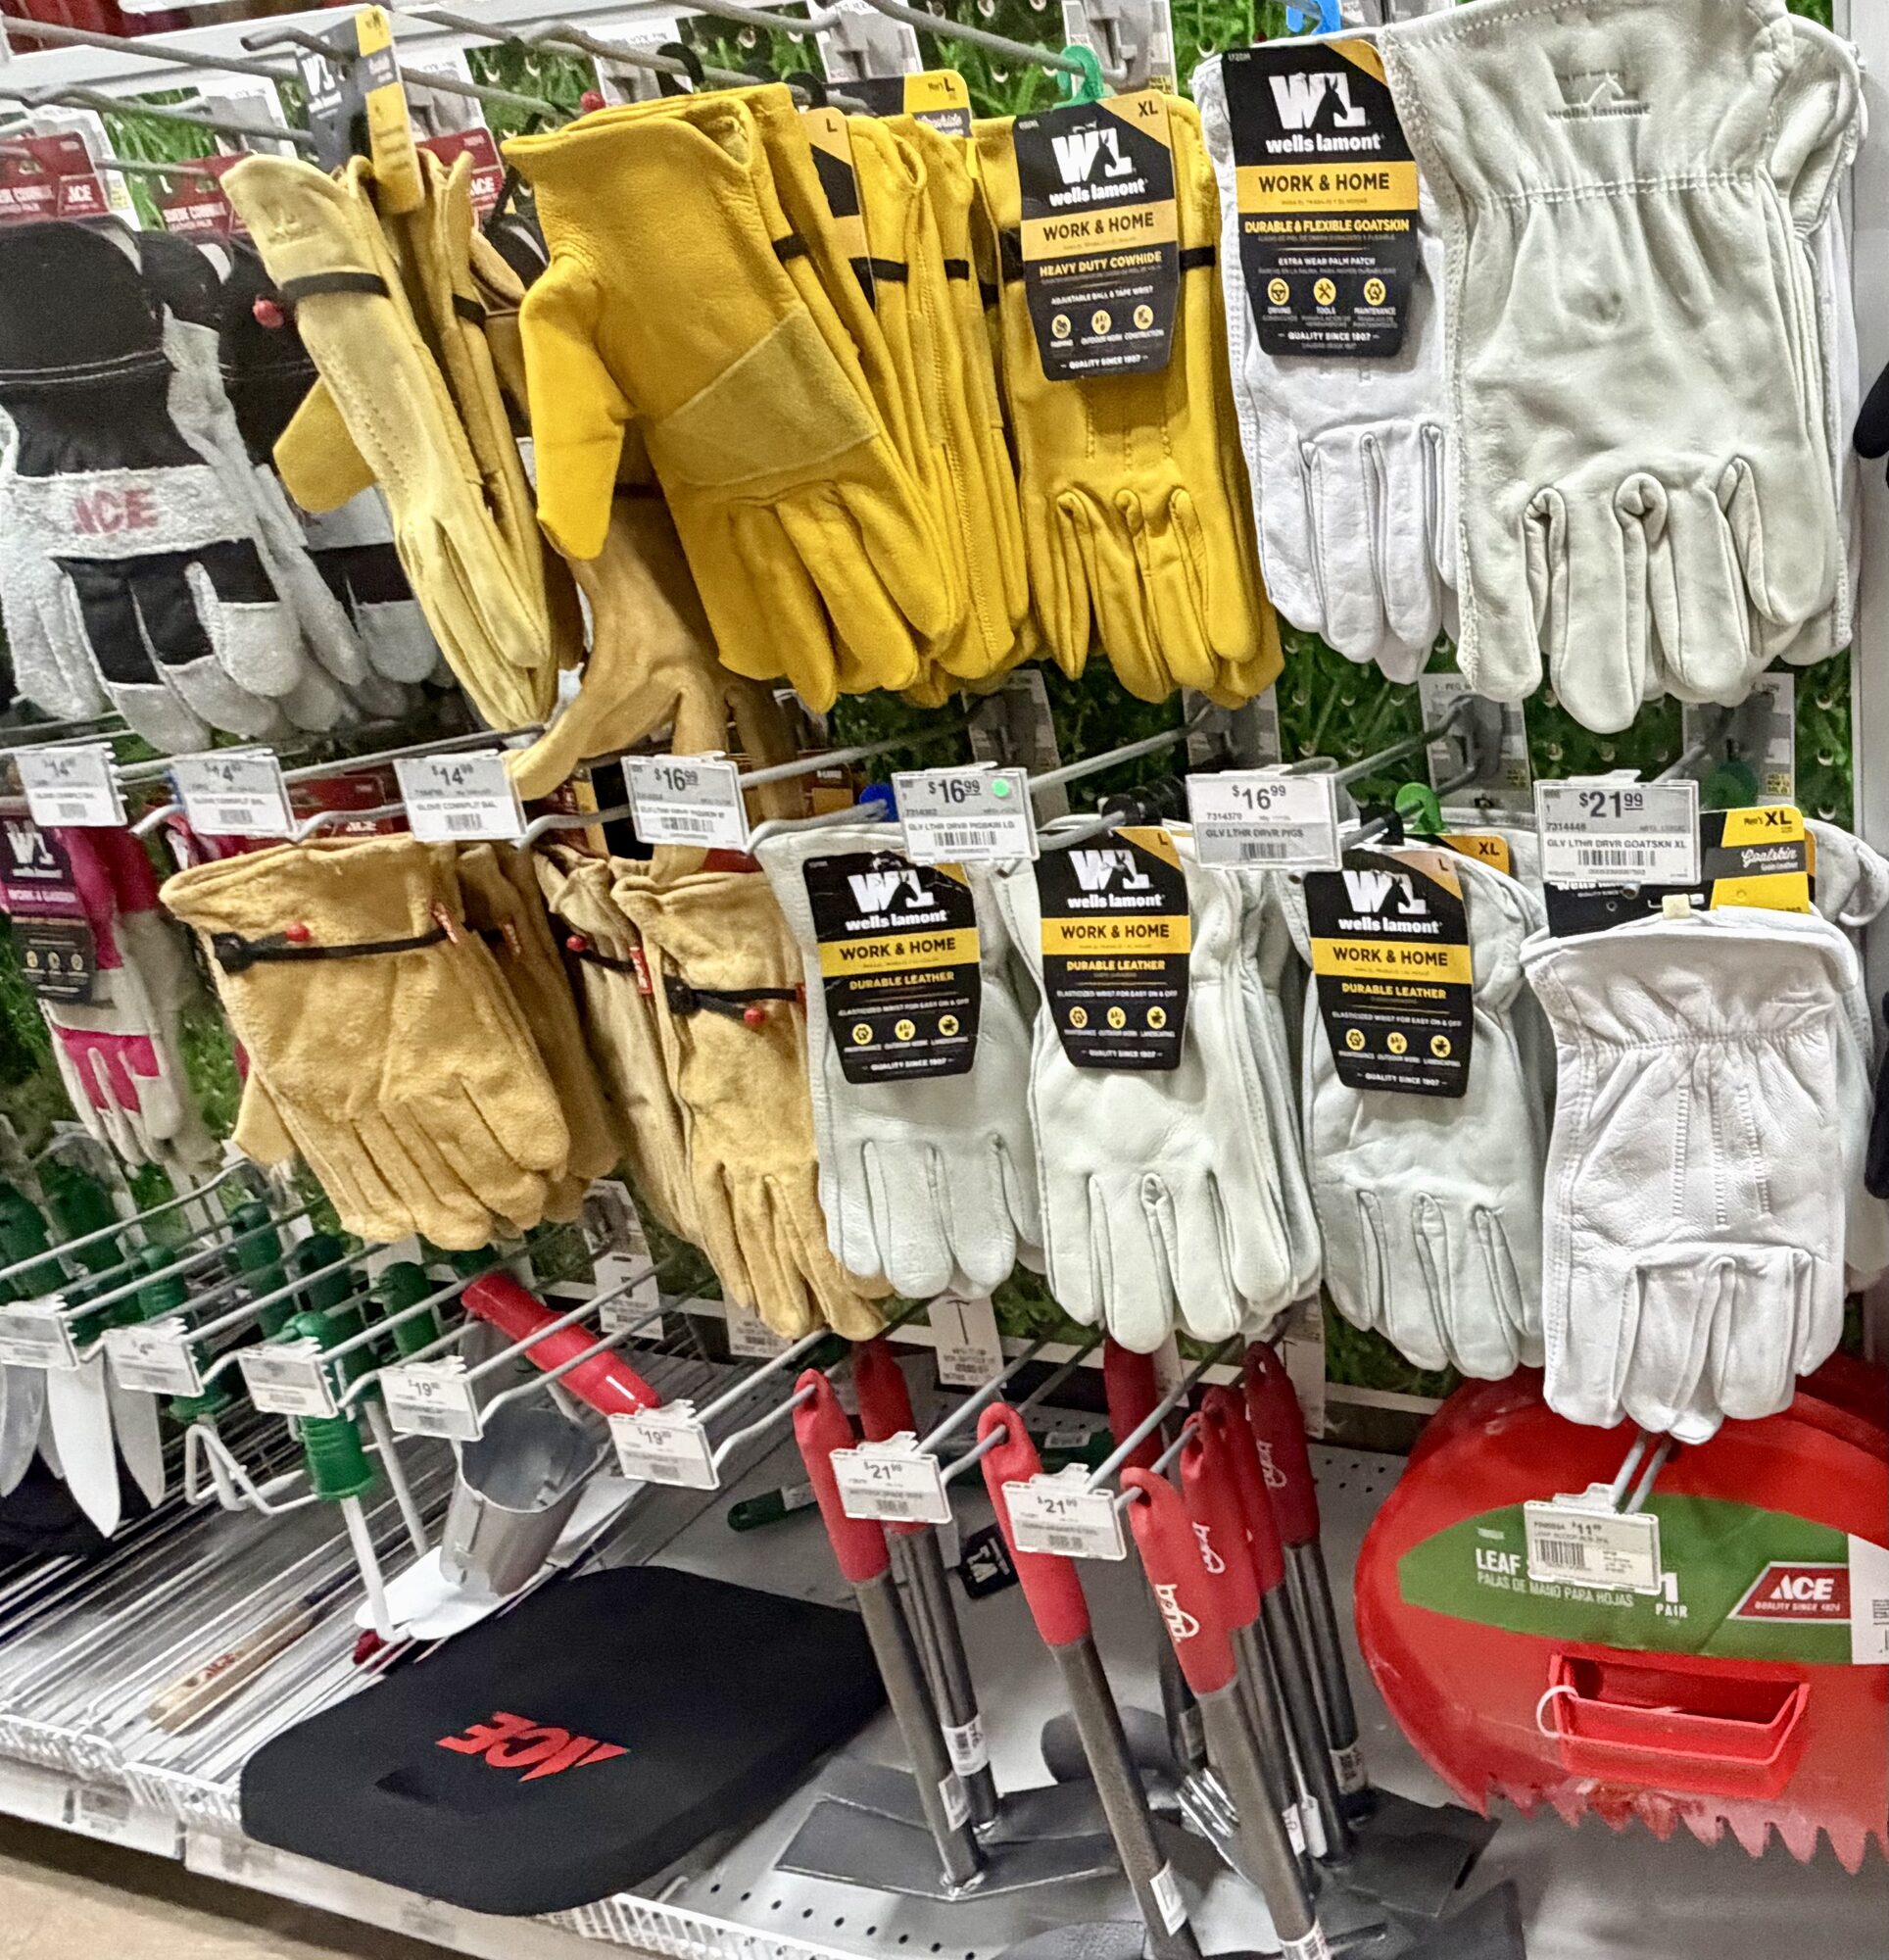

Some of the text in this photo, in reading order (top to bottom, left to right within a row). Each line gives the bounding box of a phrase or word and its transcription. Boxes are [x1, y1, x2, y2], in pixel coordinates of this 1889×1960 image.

[1138, 100, 1159, 118] XL
[826, 118, 838, 132] L
[1265, 133, 1380, 153] wells lamont
[1259, 172, 1389, 193] WORK & HOME
[1049, 179, 1146, 207] wells lamont
[1043, 212, 1154, 241] WORK & HOME
[1244, 220, 1409, 233] DURABLE & FLEXIBLE GOATSKIN
[1040, 251, 1162, 276] HEAVY DUTY COWHIDE
[1288, 332, 1323, 341] QUALITY
[1325, 332, 1349, 341] SINCE
[1069, 358, 1099, 369] QUALITY
[1101, 356, 1123, 367] SINCE
[73, 488, 159, 535] ACE
[1765, 809, 1792, 826] XL
[1158, 833, 1168, 846] L
[1206, 829, 1225, 838] GLV
[1226, 829, 1252, 838] LTHR
[1478, 842, 1499, 857] XL
[1569, 839, 1593, 848] LTHR
[1623, 839, 1671, 849] GOATSKN
[1438, 858, 1449, 871] L
[1741, 847, 1798, 868] Goatskin
[1067, 894, 1162, 908] wells lamont
[845, 909, 947, 931] wells lamont
[1338, 916, 1439, 934] wells lamont
[1061, 924, 1169, 940] WORK & HOME
[840, 938, 956, 960] WORK & HOME
[1332, 947, 1448, 966] WORK & HOME
[1067, 960, 1165, 971] DURABLE LEATHER
[849, 971, 954, 990] DURABLE LEATHER
[1341, 983, 1446, 999] DURABLE LEATHER
[1476, 1547, 1522, 1576] LEAF
[1477, 1573, 1634, 1607] PALAS DE MANO PARA HOJAS
[1661, 1572, 1678, 1603] 1
[1769, 1574, 1835, 1600] ACE
[1656, 1603, 1688, 1618] PAIR
[1755, 1601, 1790, 1610] QUALITY
[1792, 1602, 1817, 1611] SINCE
[435, 1711, 631, 1783] ACE
